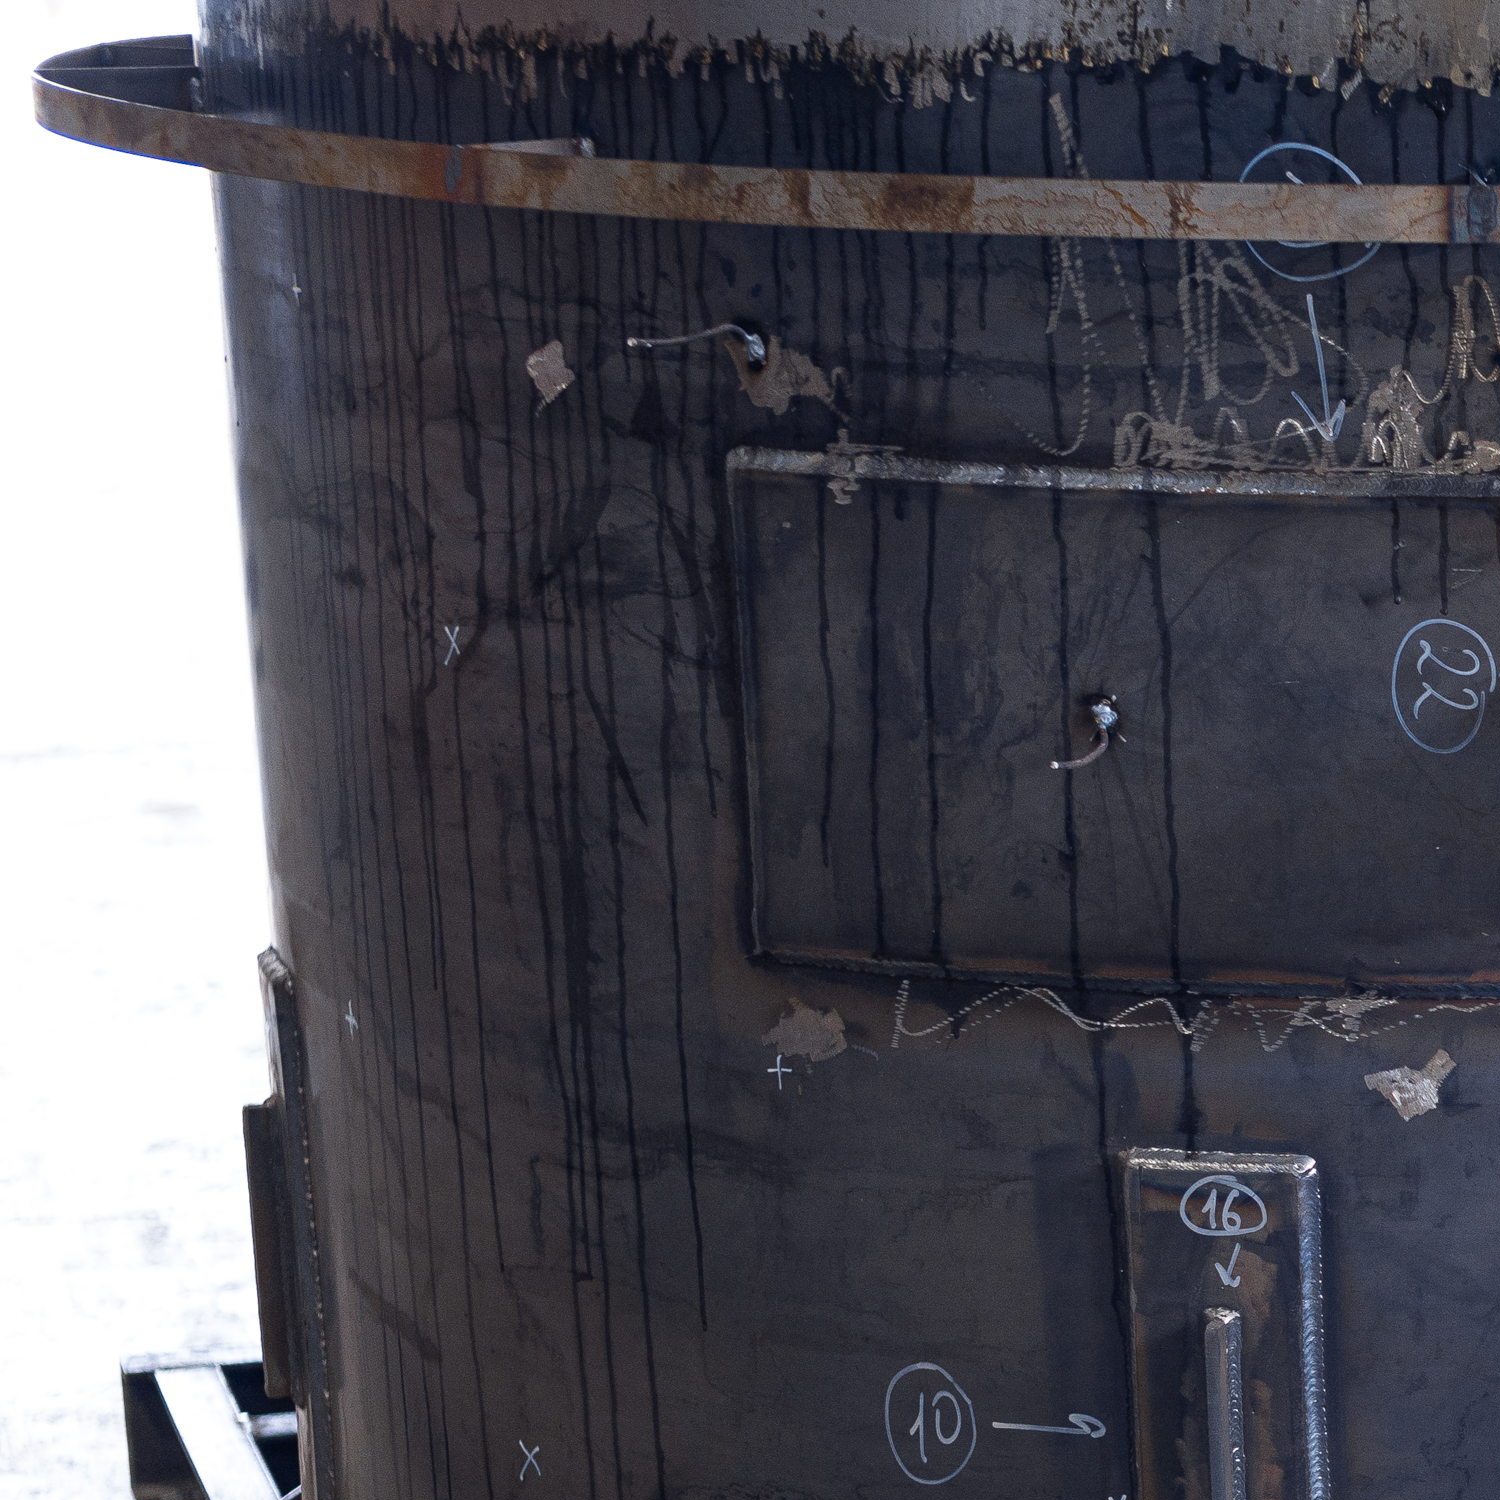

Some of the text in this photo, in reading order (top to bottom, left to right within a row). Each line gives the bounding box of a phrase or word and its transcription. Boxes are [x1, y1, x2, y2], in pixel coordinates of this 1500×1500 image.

[1412, 639, 1480, 720] 22
[1200, 1187, 1242, 1231] 16
[908, 1389, 963, 1465] 10
